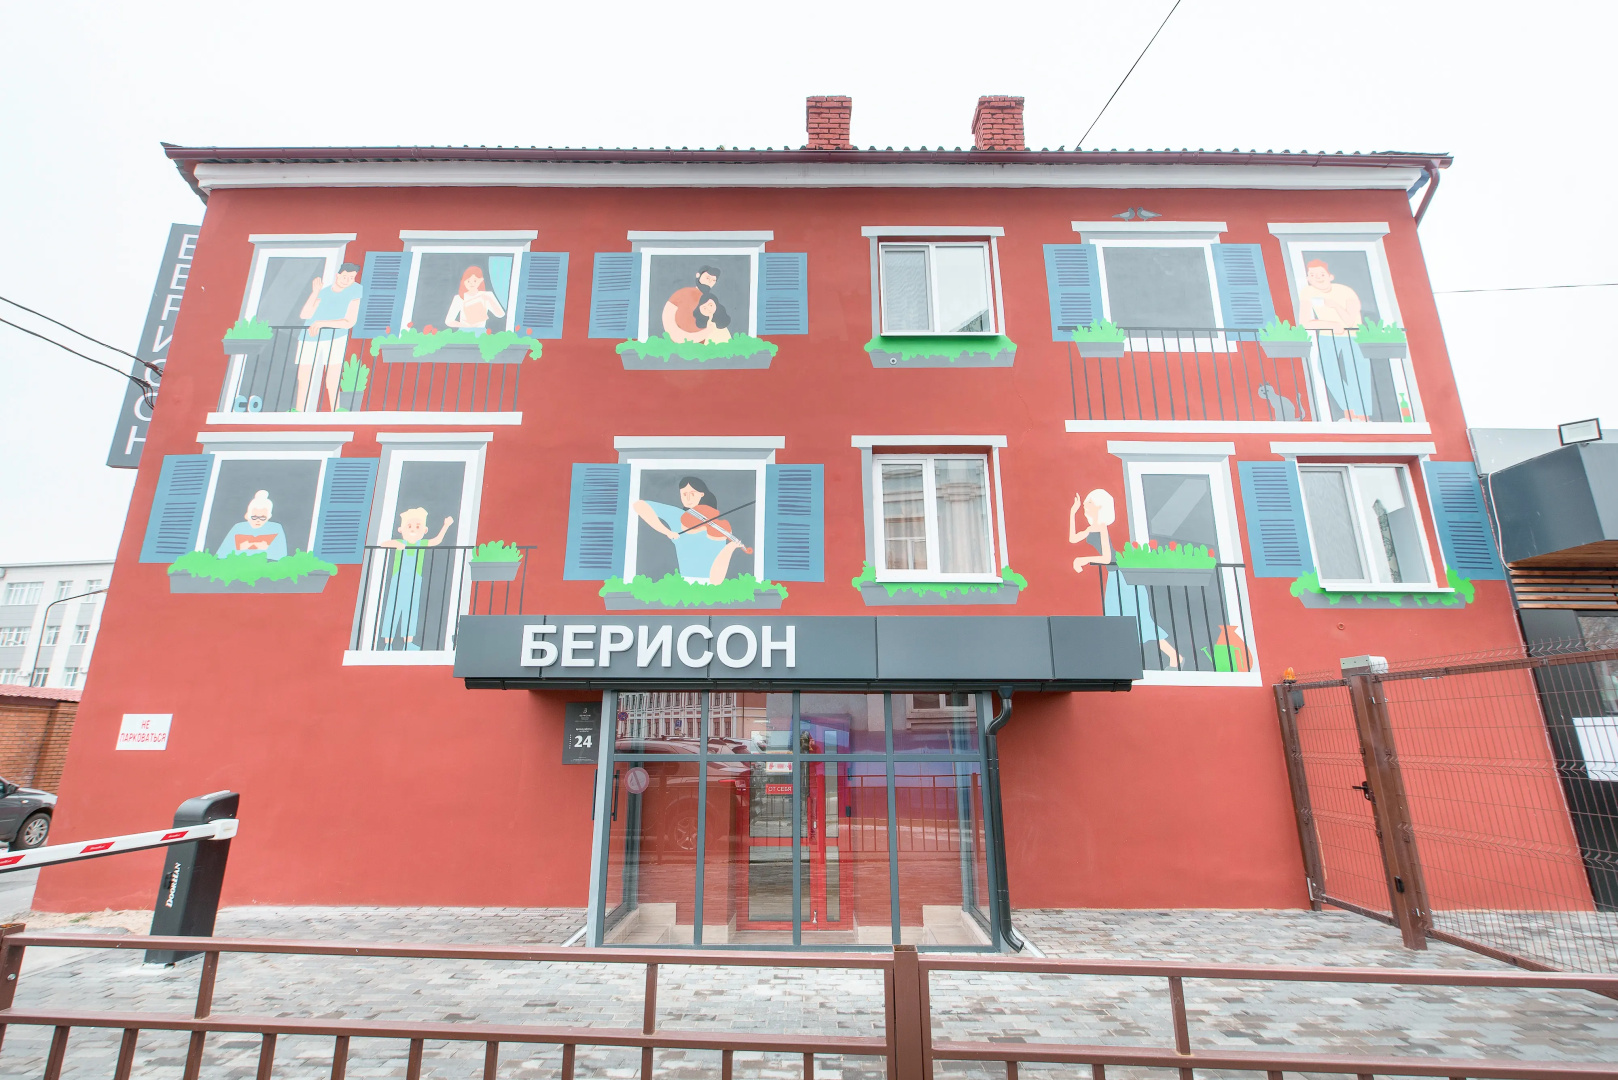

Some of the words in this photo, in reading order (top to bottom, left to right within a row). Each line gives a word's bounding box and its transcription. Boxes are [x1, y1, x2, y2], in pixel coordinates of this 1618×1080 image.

[520, 624, 796, 668] БЕРИСОН
[141, 719, 151, 729] НЕ
[120, 733, 167, 742] ПАРКОВАТЬСЯ
[574, 735, 593, 748] 24
